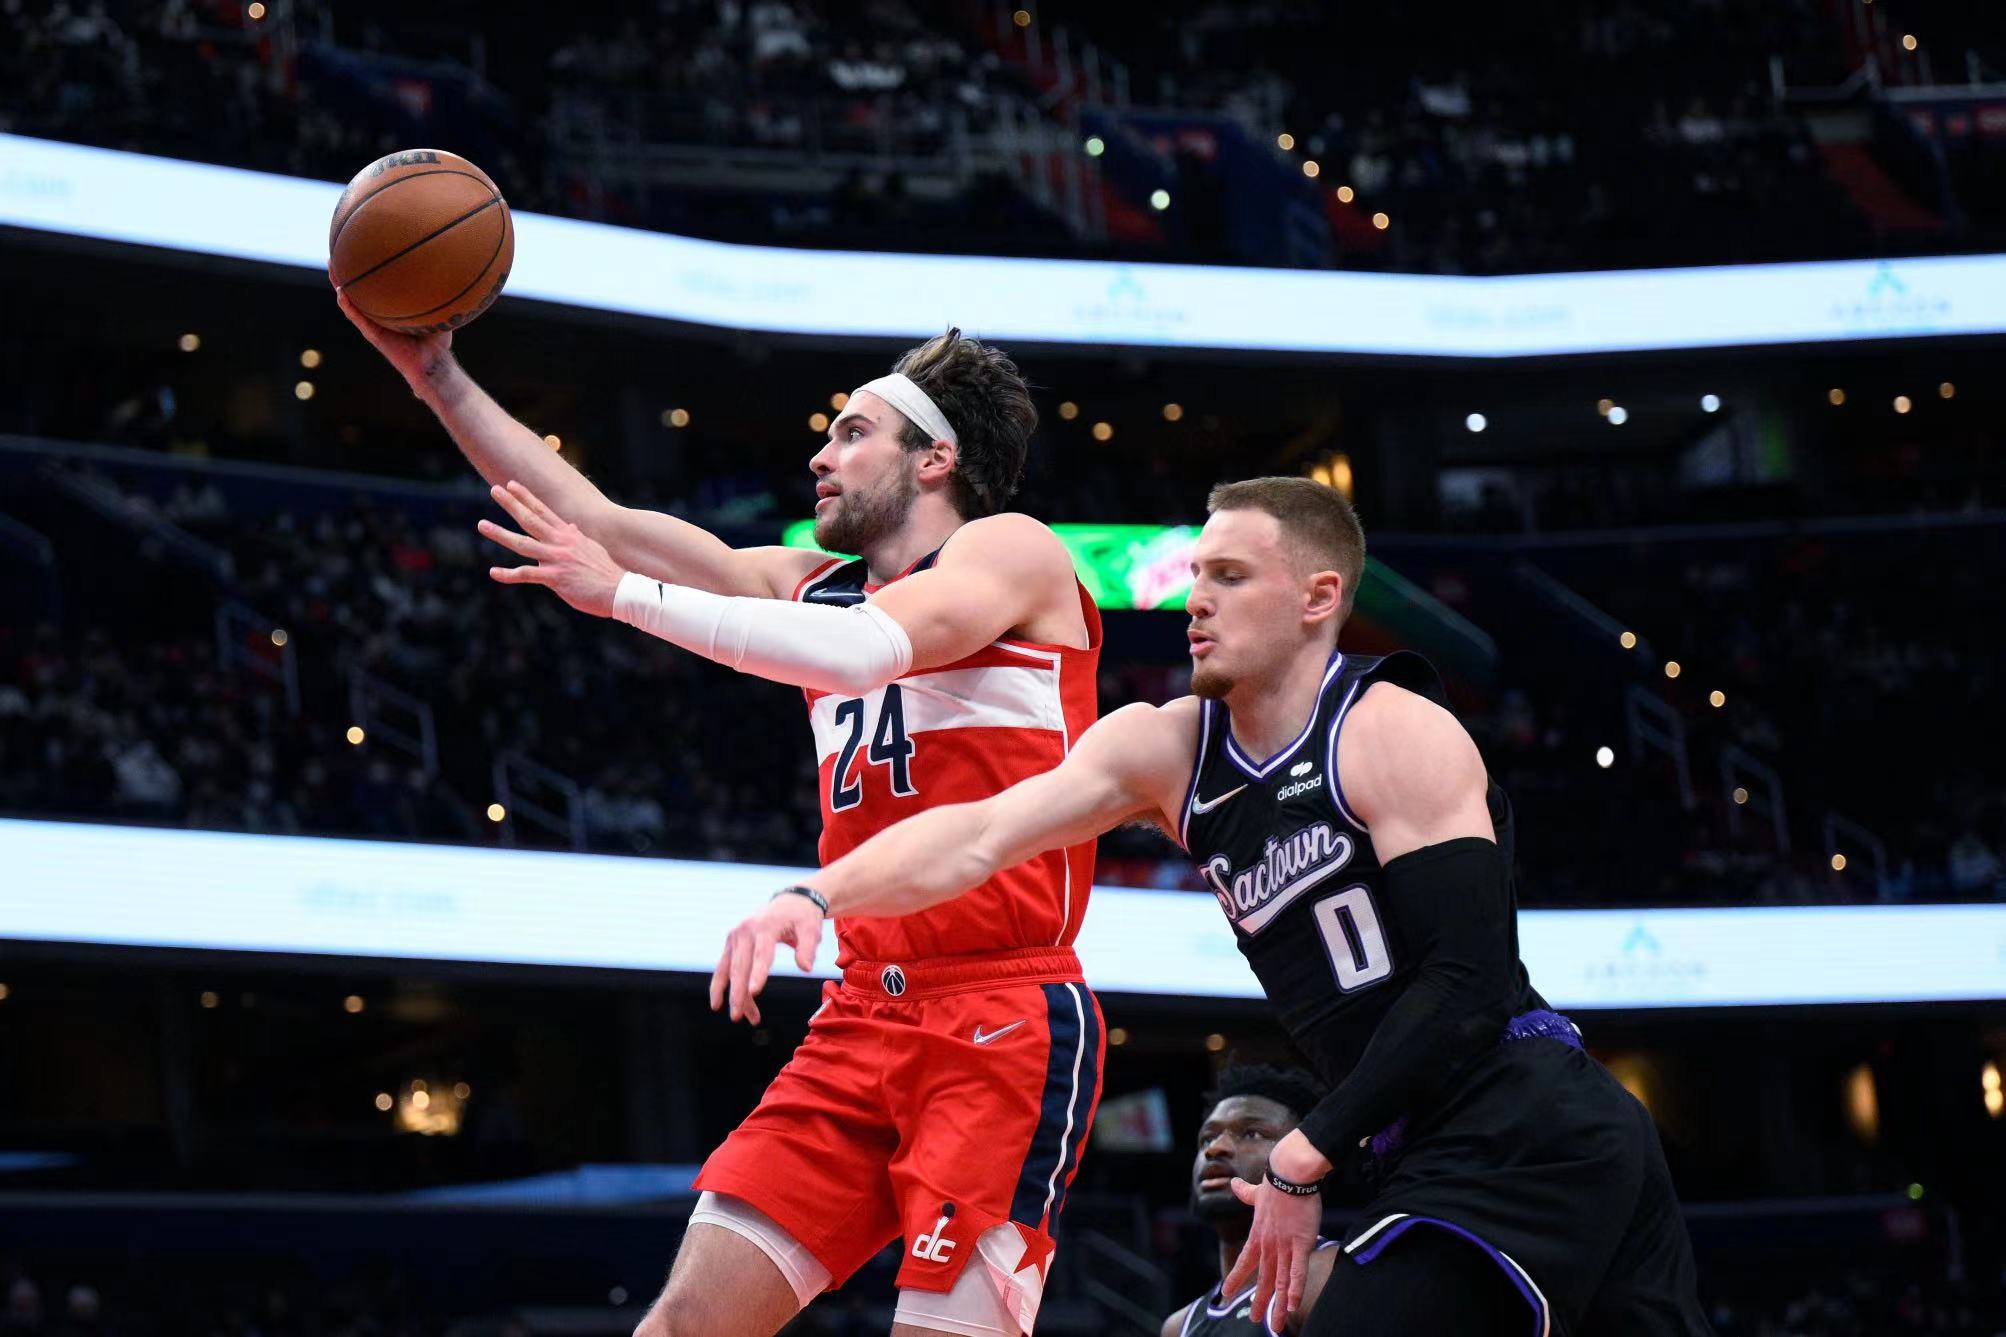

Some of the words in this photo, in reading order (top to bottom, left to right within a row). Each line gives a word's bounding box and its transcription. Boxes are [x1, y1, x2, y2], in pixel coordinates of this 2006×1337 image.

[831, 682, 918, 813] 24
[1277, 774, 1323, 801] dialpad
[1199, 820, 1354, 936] Sactown
[1311, 883, 1394, 994] 0
[1272, 1177, 1293, 1194] Stay
[1295, 1185, 1318, 1194] True
